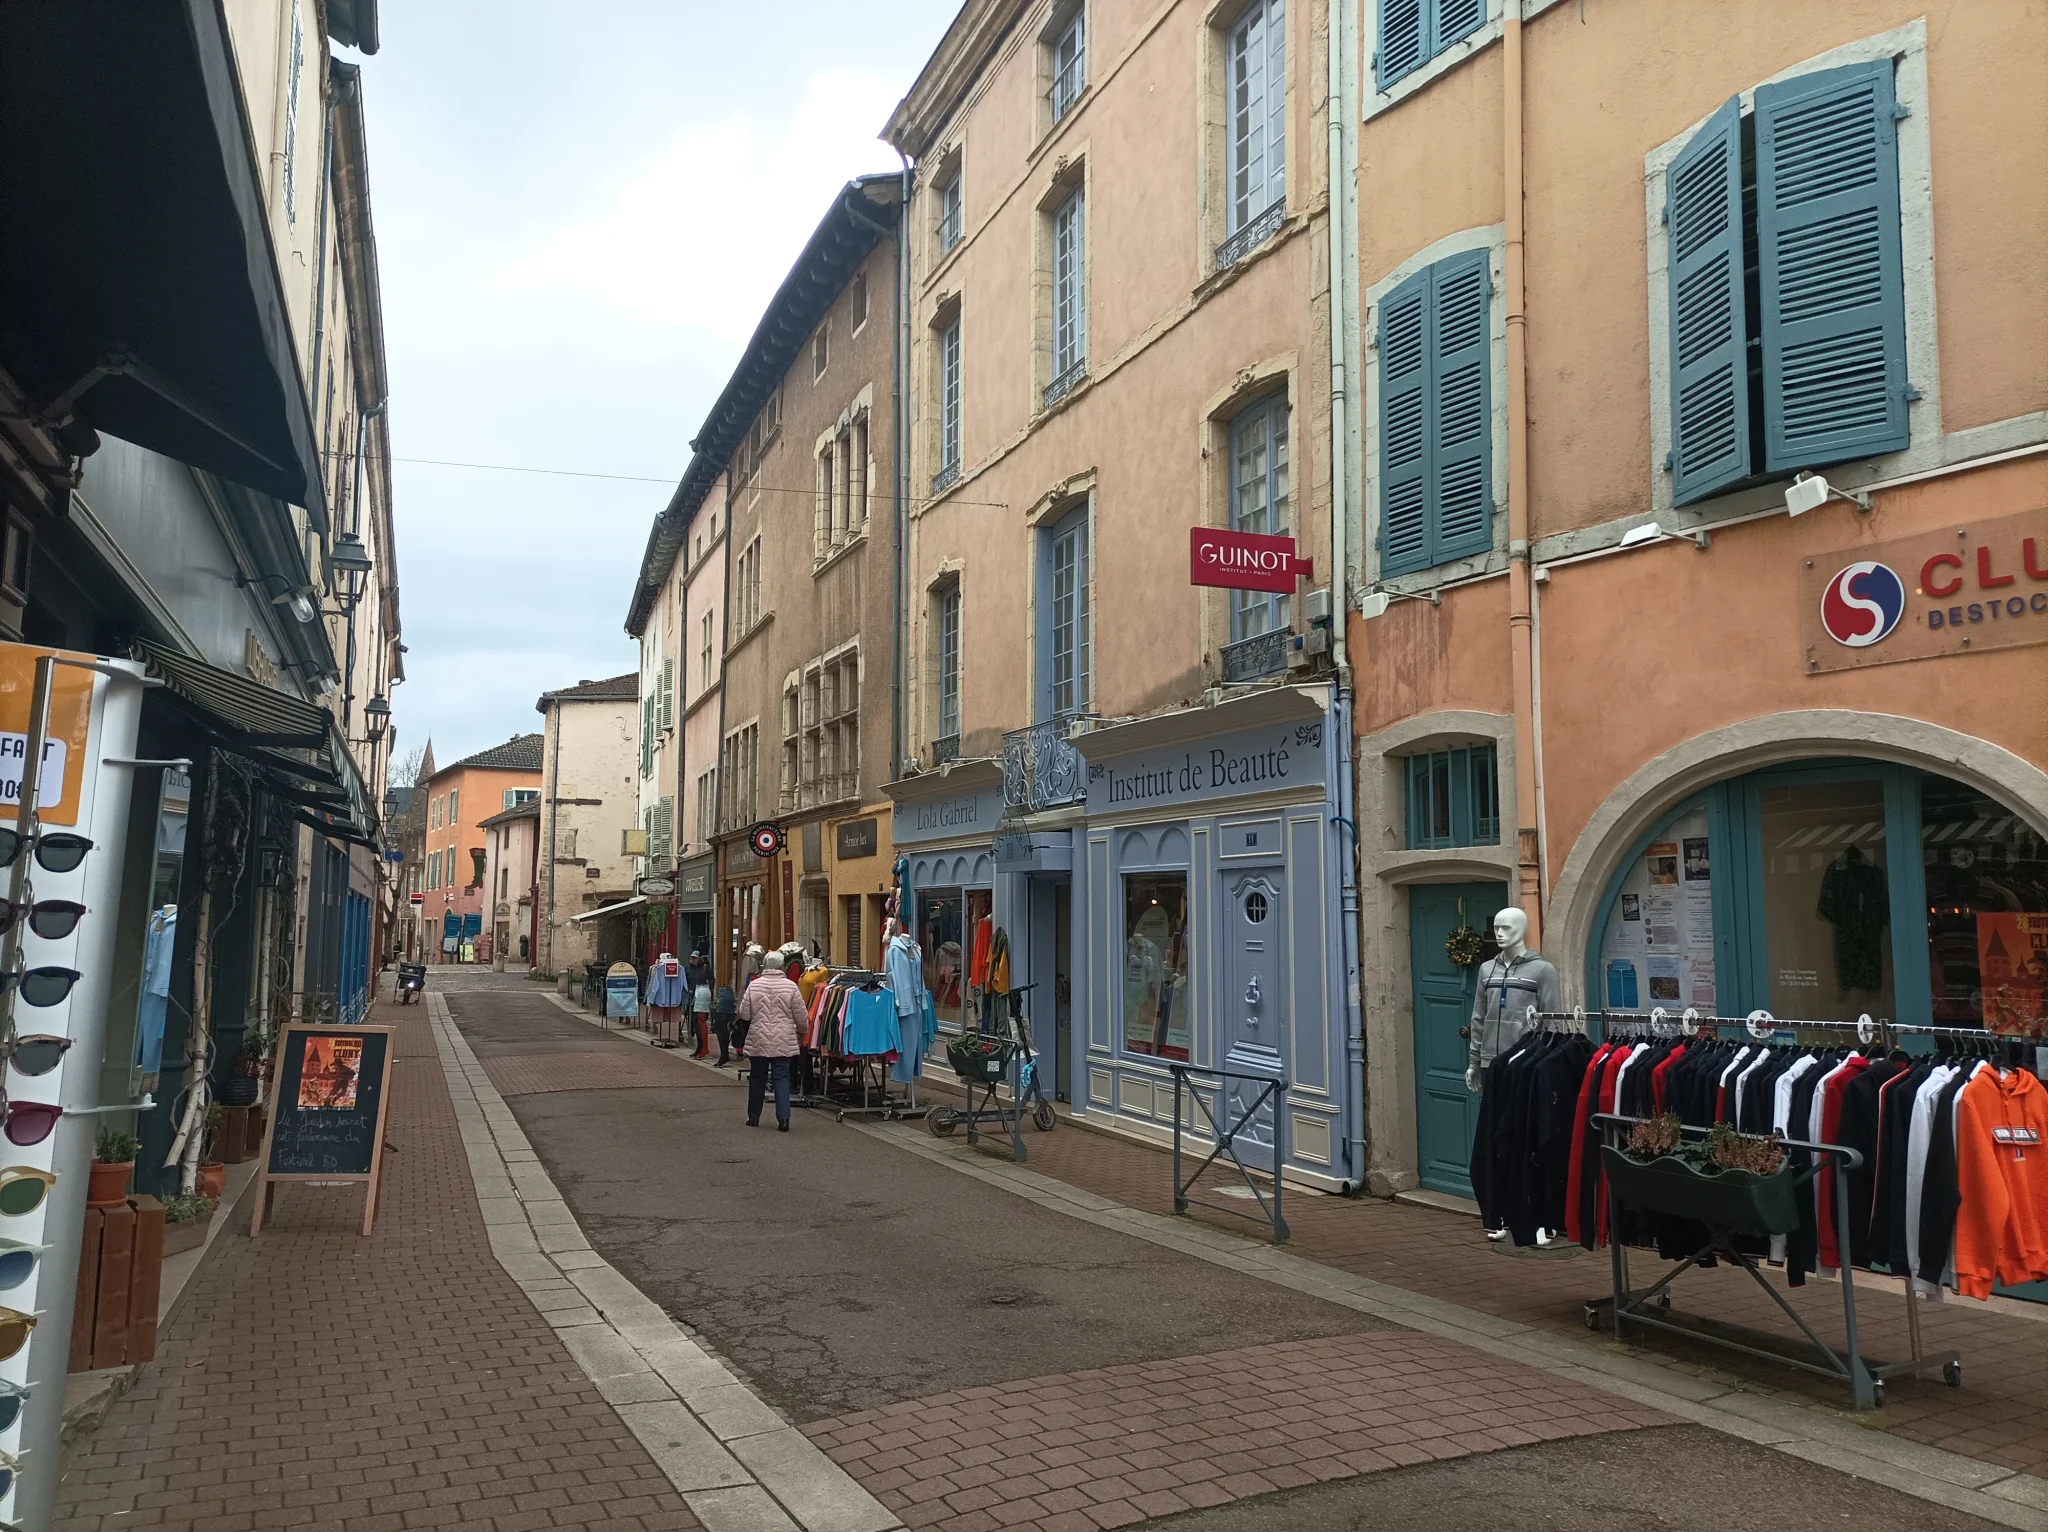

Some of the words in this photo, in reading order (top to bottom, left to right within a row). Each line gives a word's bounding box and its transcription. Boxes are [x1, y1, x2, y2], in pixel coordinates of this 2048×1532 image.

[1199, 543, 1291, 571] GUINOT
[1928, 592, 2048, 630] DESTOC
[1108, 763, 1173, 803] Institut
[1179, 753, 1202, 791] de
[1210, 736, 1289, 788] Beauté
[917, 804, 937, 830] Lola
[940, 796, 978, 826] Gabriel
[752, 846, 770, 856] PERRIN
[278, 1108, 291, 1126] Le
[345, 1129, 360, 1143] du
[278, 1148, 314, 1167] Festival
[323, 1154, 337, 1168] BD
